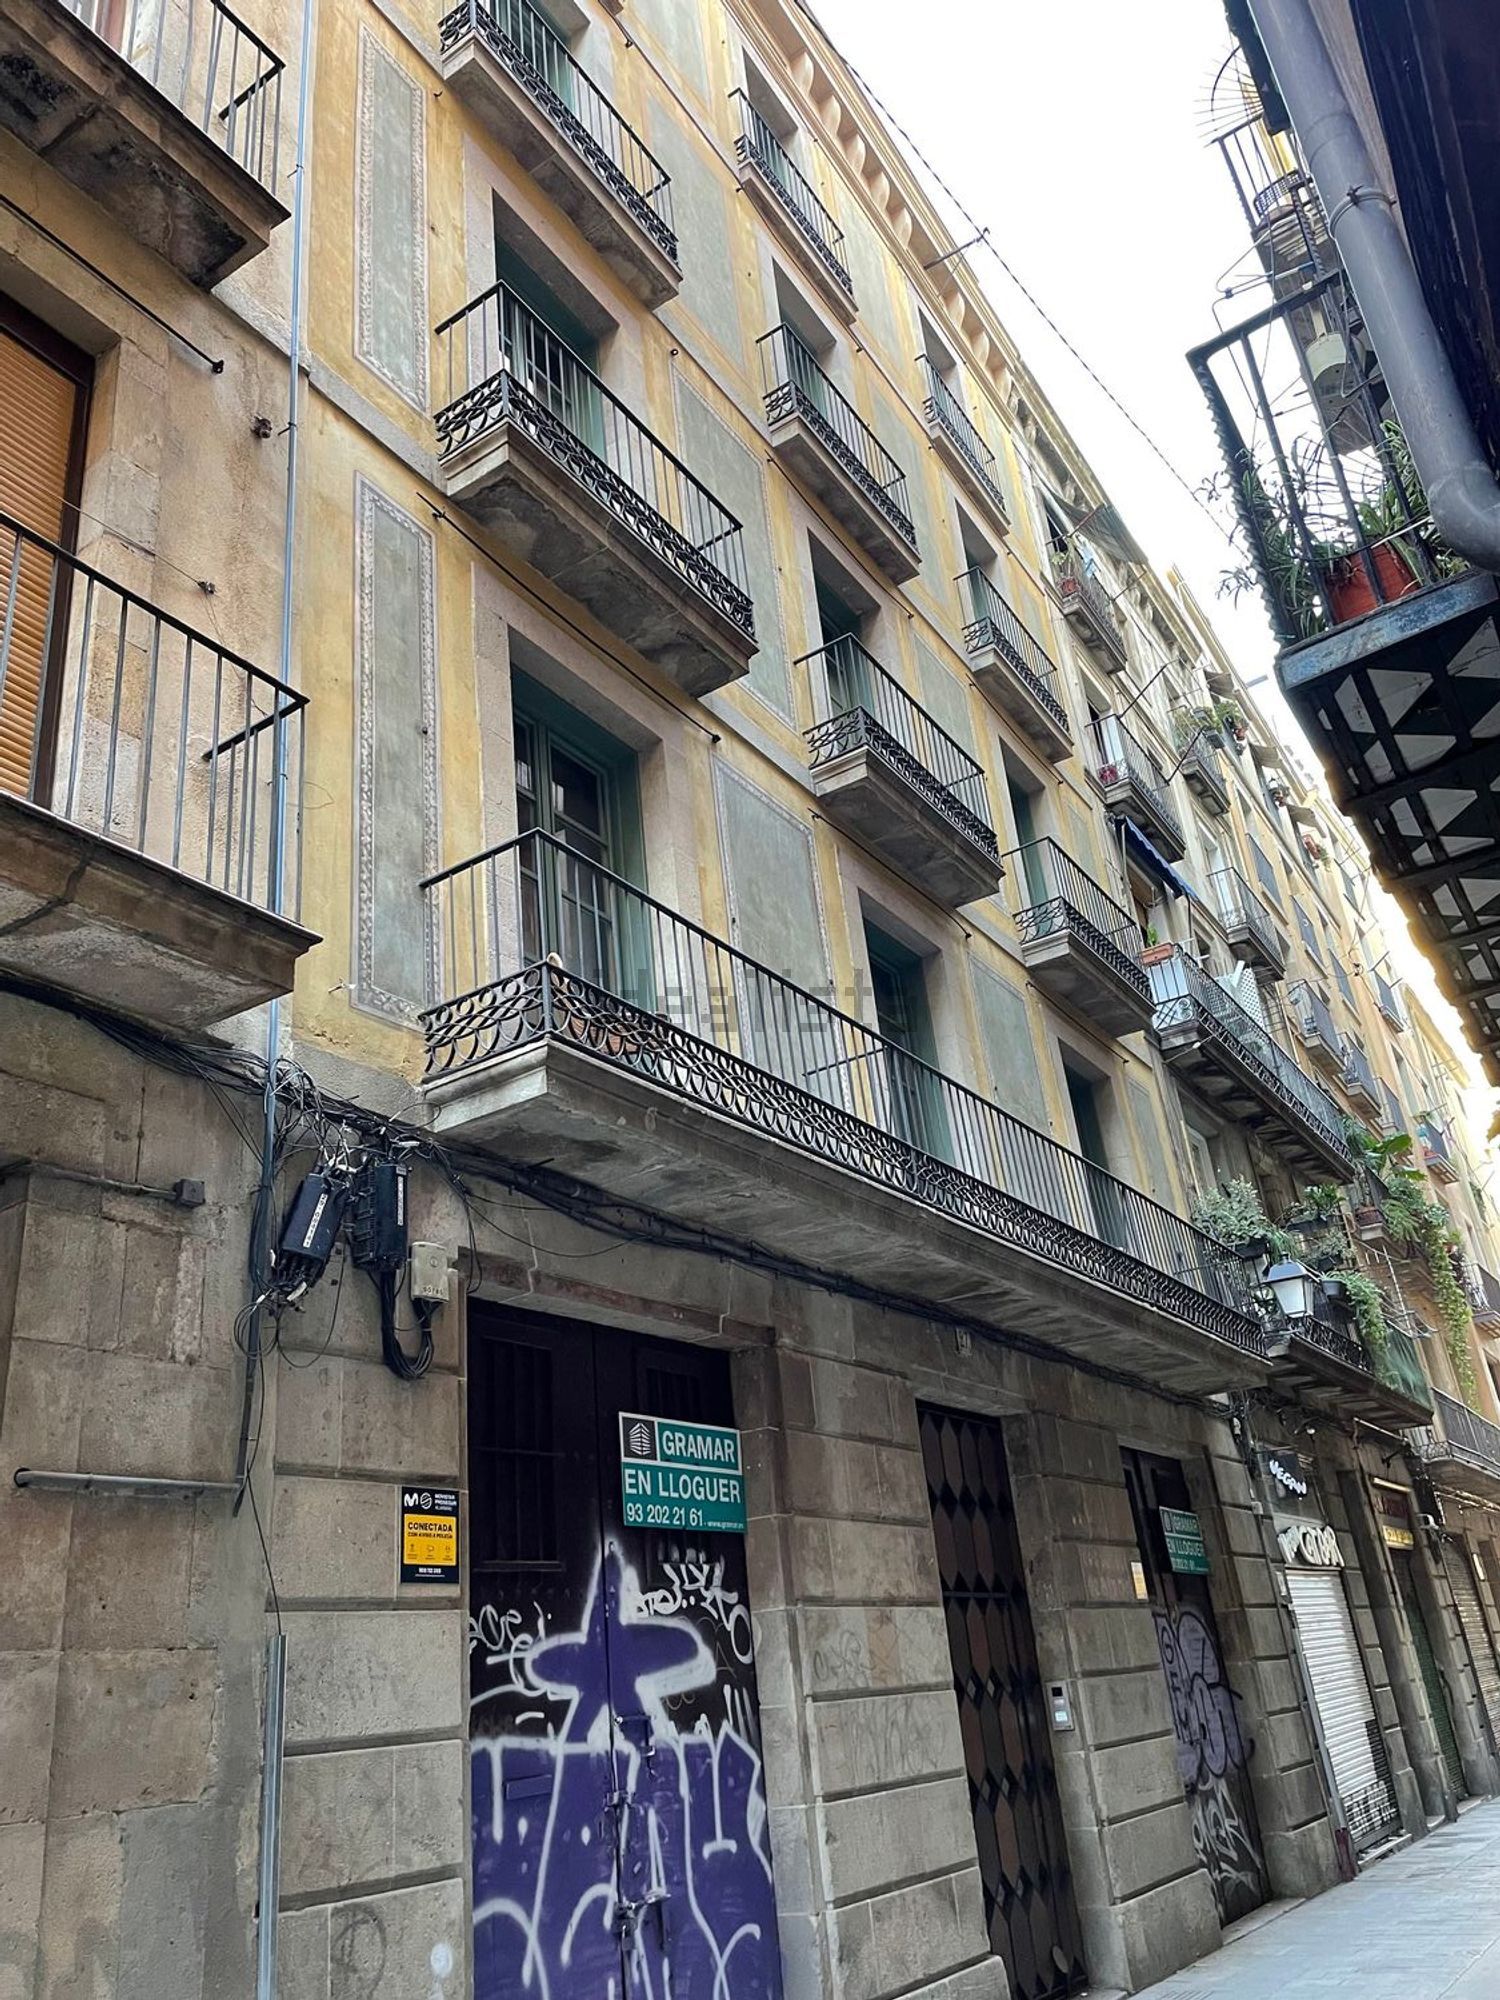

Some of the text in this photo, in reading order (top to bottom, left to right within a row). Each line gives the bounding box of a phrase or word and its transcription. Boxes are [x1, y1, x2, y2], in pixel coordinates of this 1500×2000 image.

[662, 1430, 735, 1463] GRAMAR
[624, 1469, 741, 1503] EN LLOGUER
[1269, 1459, 1307, 1495] VEGAN
[408, 1522, 452, 1532] CONECTADA
[626, 1502, 643, 1522] 93
[646, 1504, 670, 1524] 202
[672, 1507, 685, 1526] 21
[689, 1508, 703, 1526] 61
